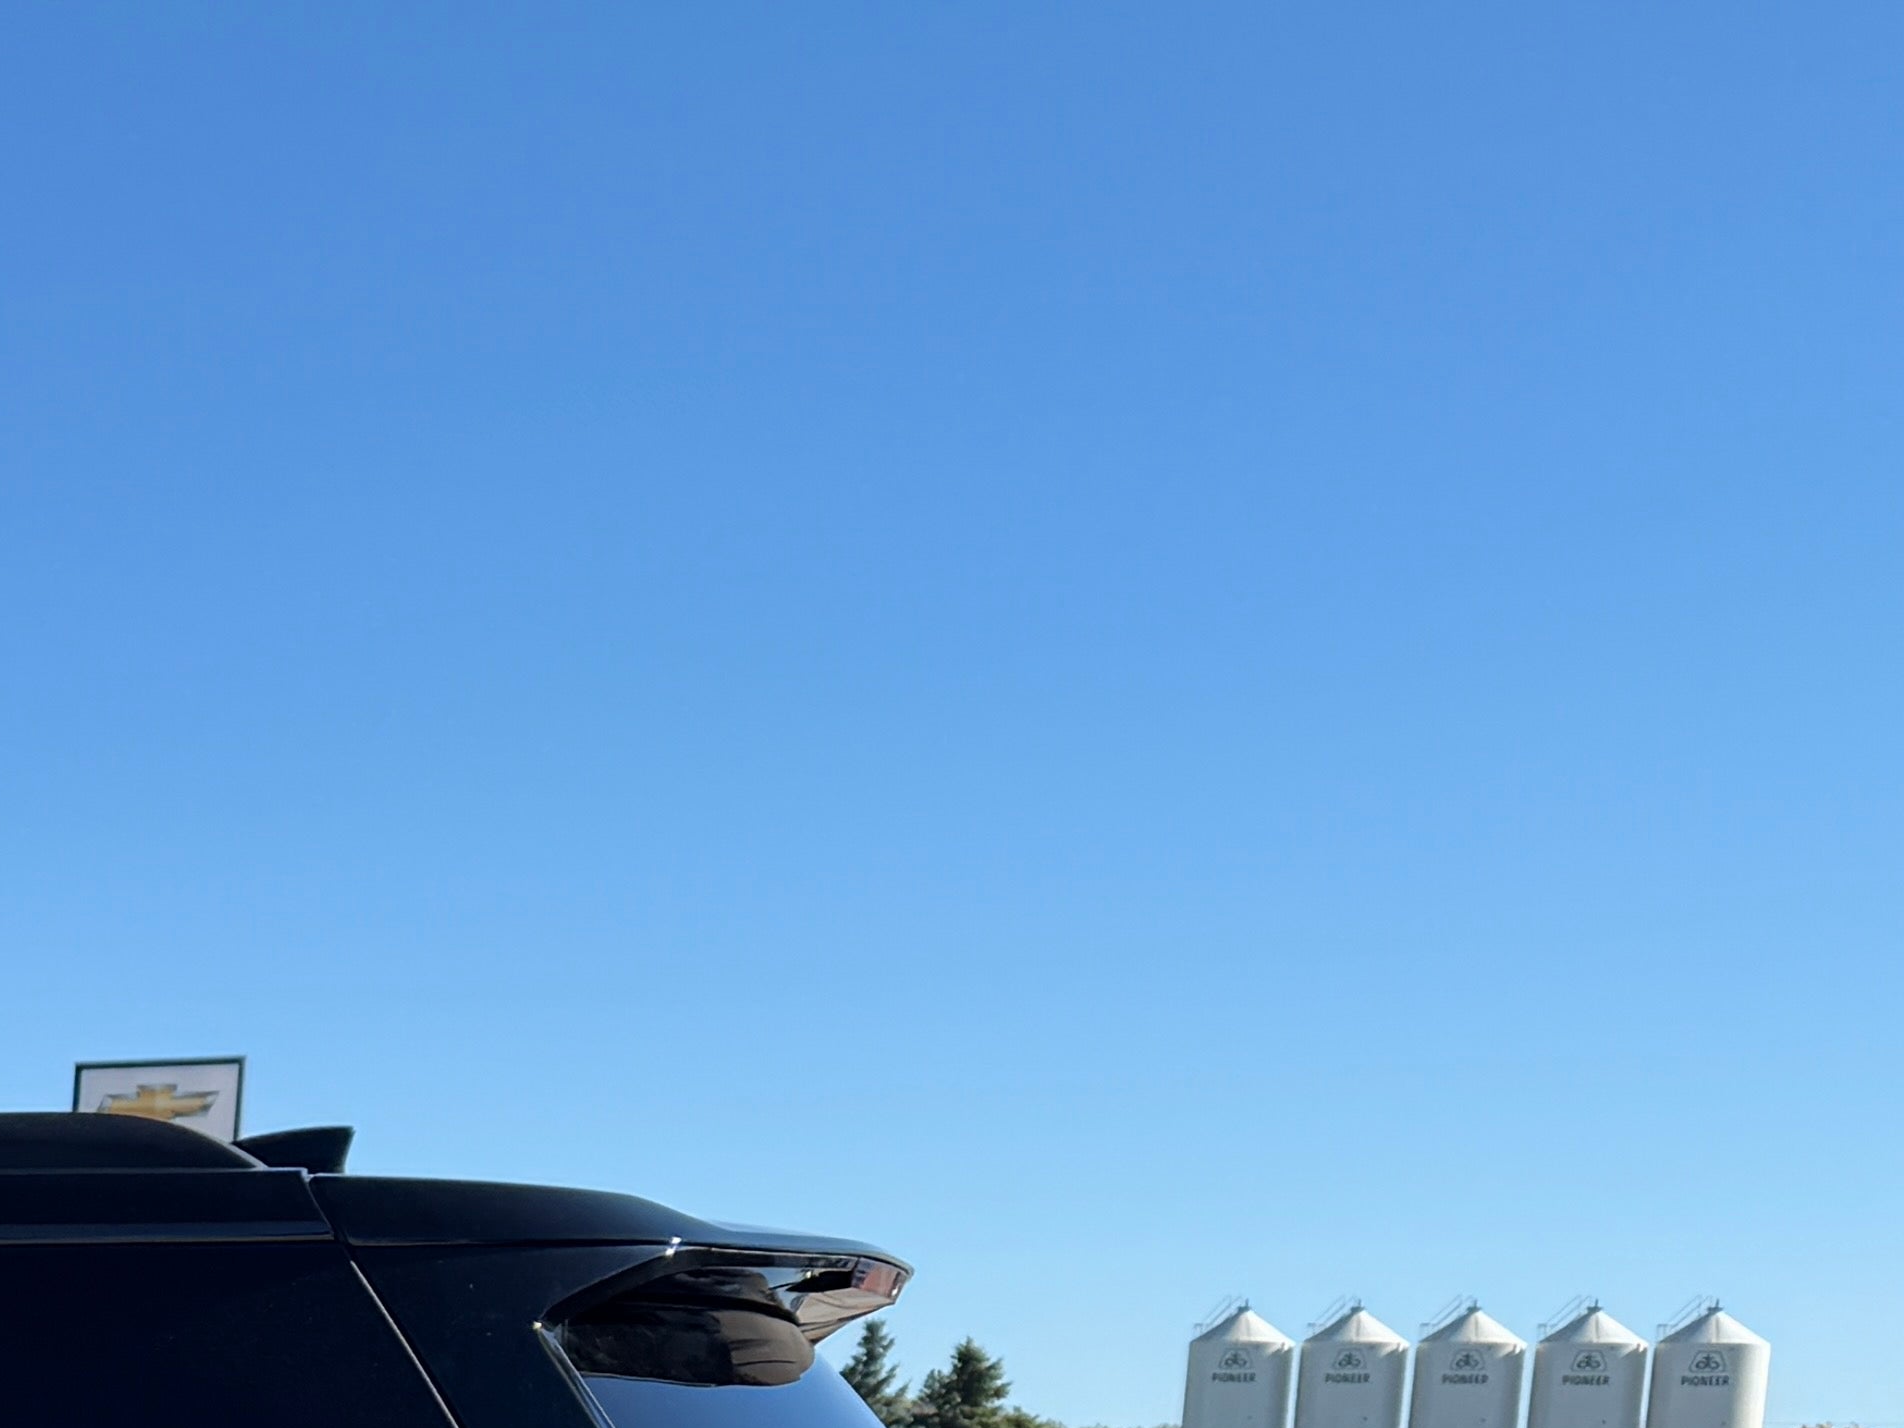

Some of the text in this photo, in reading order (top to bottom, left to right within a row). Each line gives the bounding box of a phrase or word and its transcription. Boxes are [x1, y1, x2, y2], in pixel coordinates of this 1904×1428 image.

[1212, 1372, 1257, 1383] PIONEER
[1325, 1372, 1371, 1384] PIONEER
[1442, 1373, 1489, 1385] PIONEER
[1562, 1375, 1610, 1386] PIONEER
[1681, 1375, 1730, 1386] PIONEER
